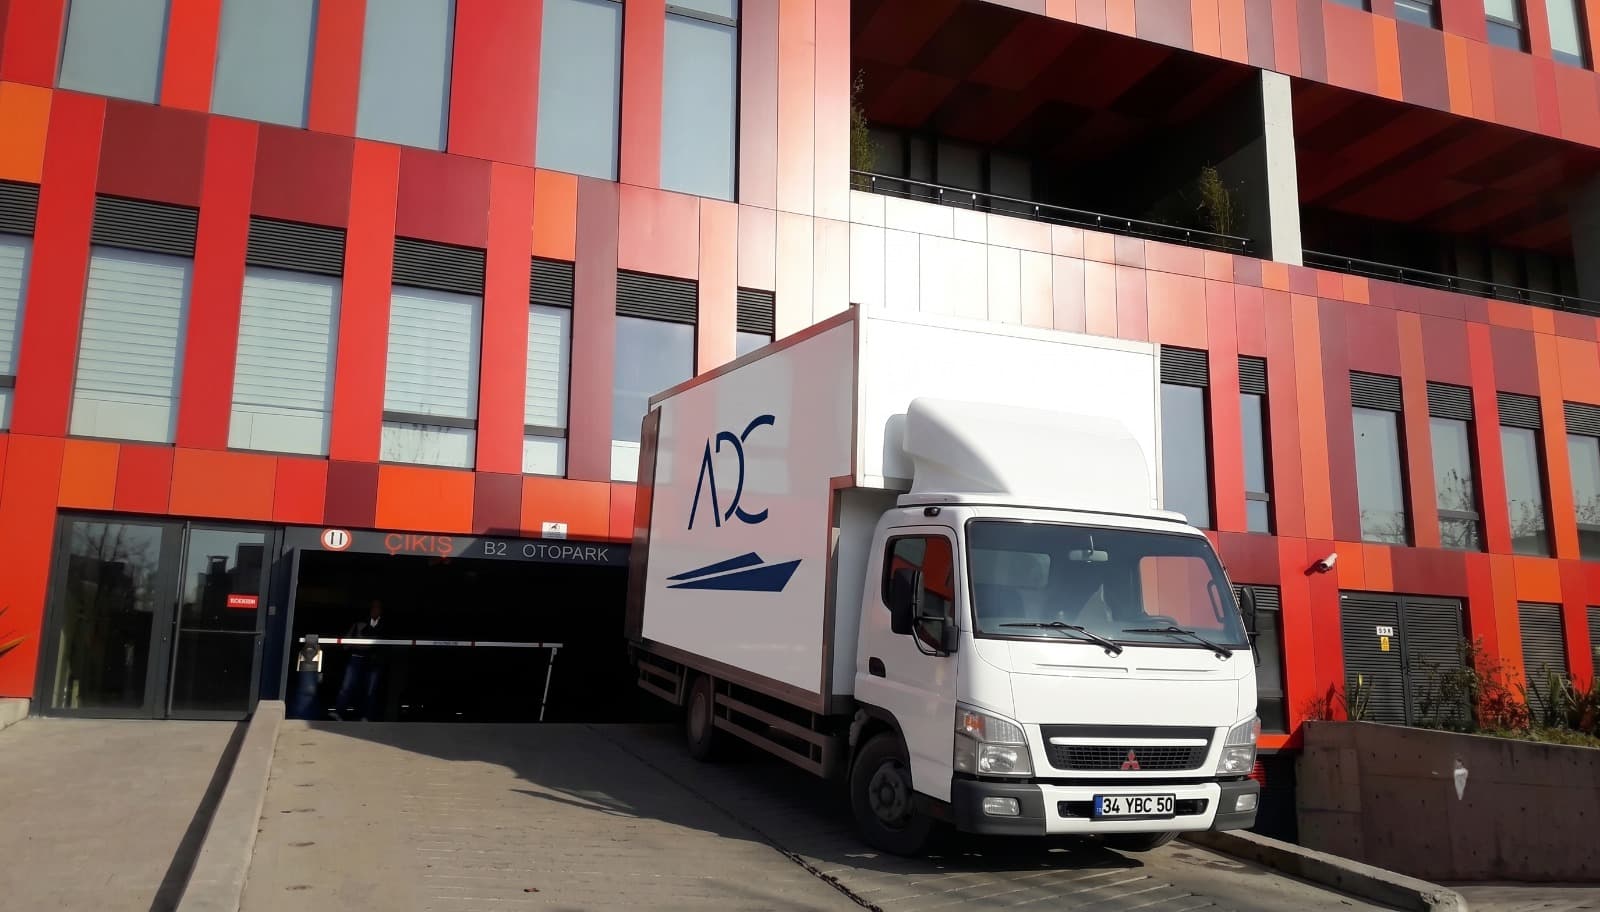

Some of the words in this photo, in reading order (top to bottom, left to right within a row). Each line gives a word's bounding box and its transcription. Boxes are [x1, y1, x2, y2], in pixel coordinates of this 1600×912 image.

[484, 541, 507, 556] B2
[522, 544, 609, 562] OTOPARK
[1103, 798, 1120, 813] 34
[1126, 798, 1153, 813] YBC
[1157, 797, 1173, 812] 50
